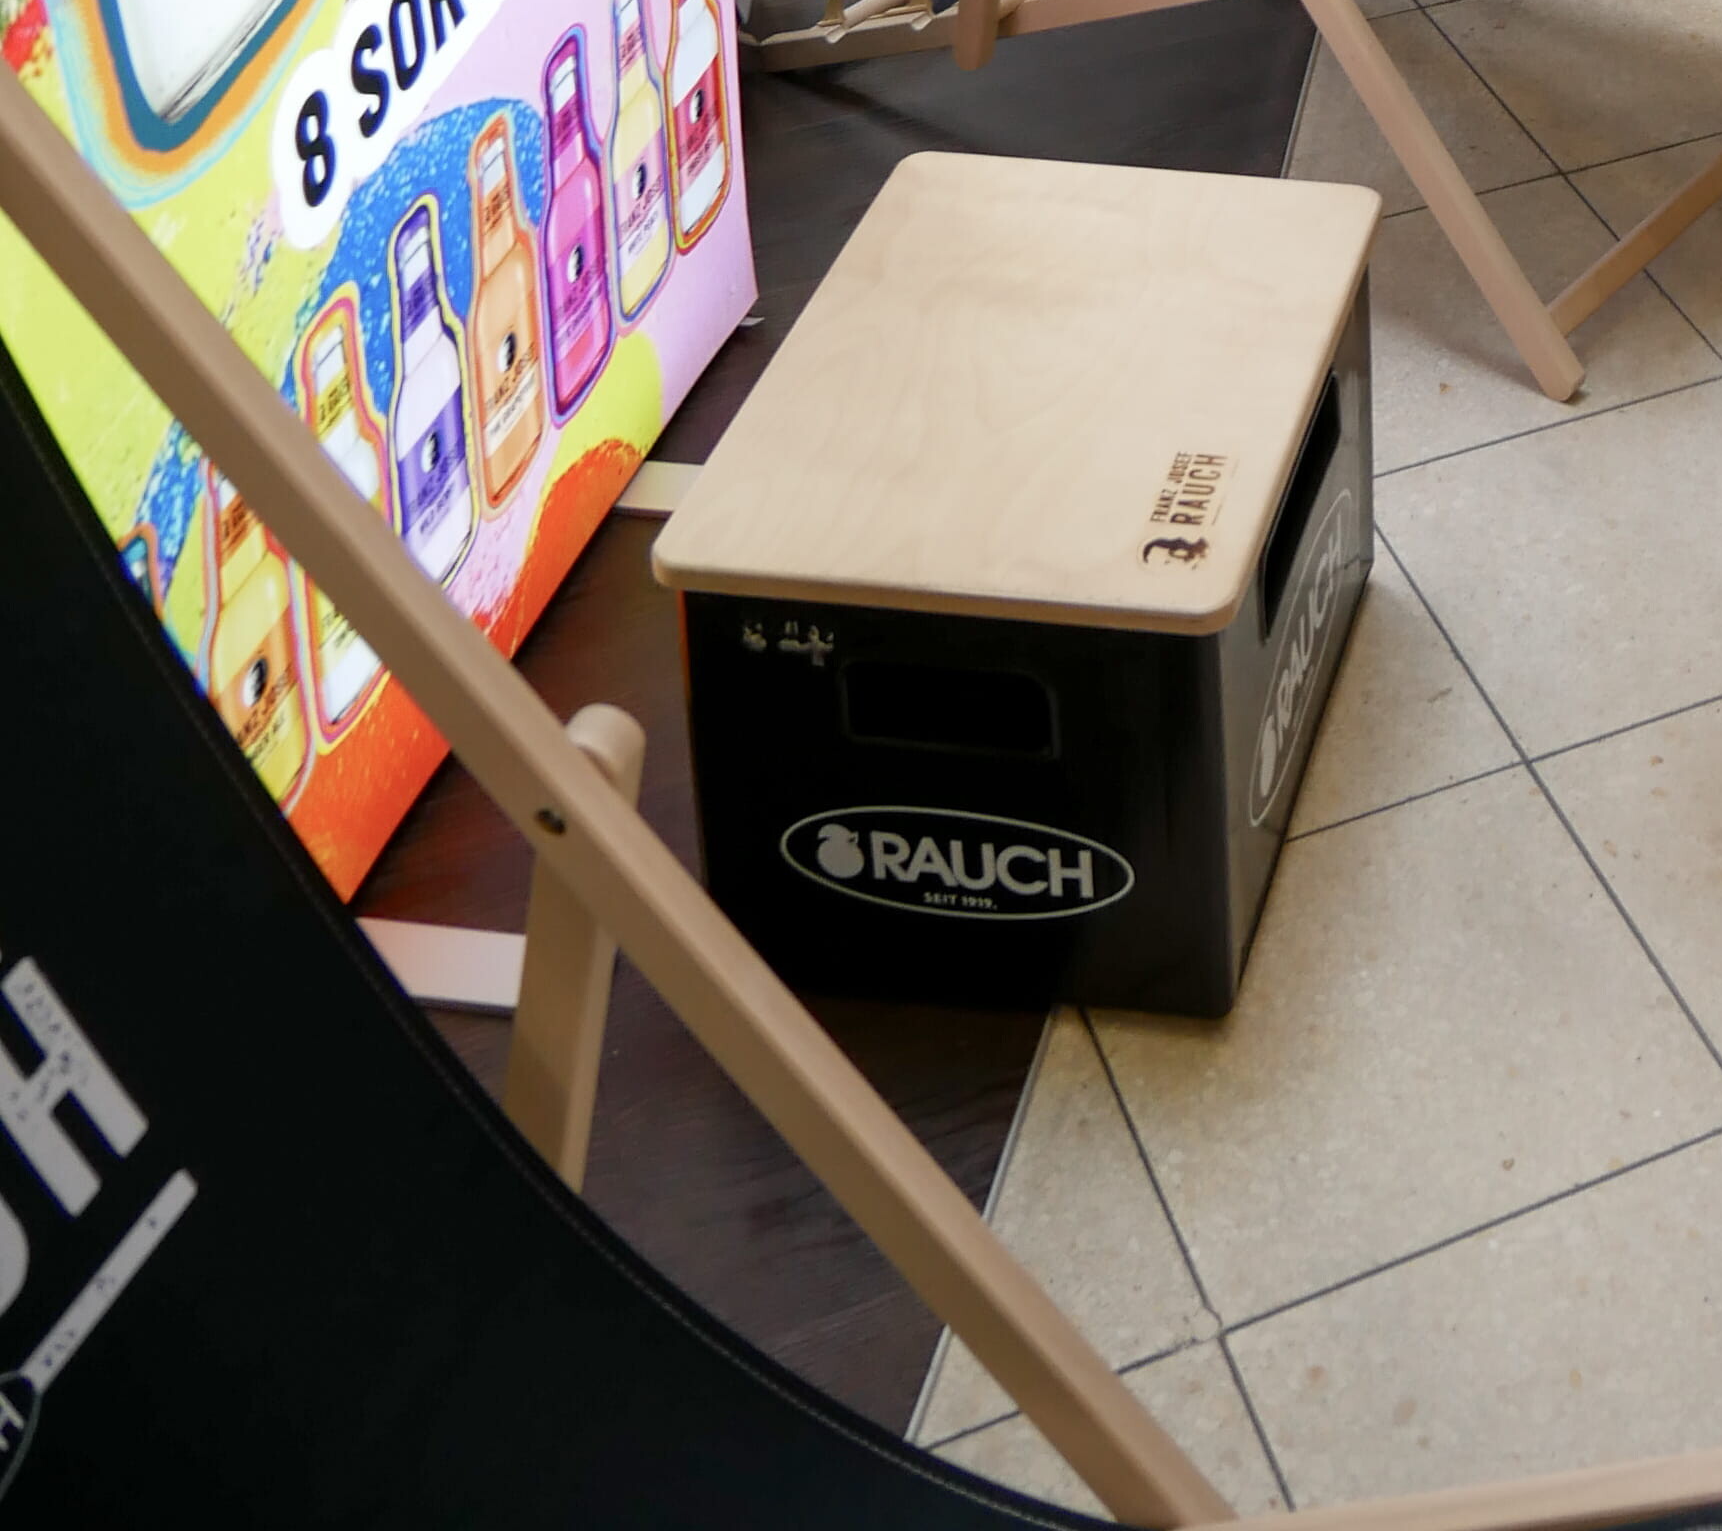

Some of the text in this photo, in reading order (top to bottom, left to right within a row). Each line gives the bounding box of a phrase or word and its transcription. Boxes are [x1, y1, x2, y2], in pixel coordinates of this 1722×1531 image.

[296, 89, 337, 208] 8
[1150, 451, 1192, 523] FRANZ JOSEF
[1169, 453, 1228, 526] RAUCH
[1277, 512, 1342, 753] RAUCH
[869, 829, 1095, 899] RAUCH
[923, 891, 958, 906] SEIT
